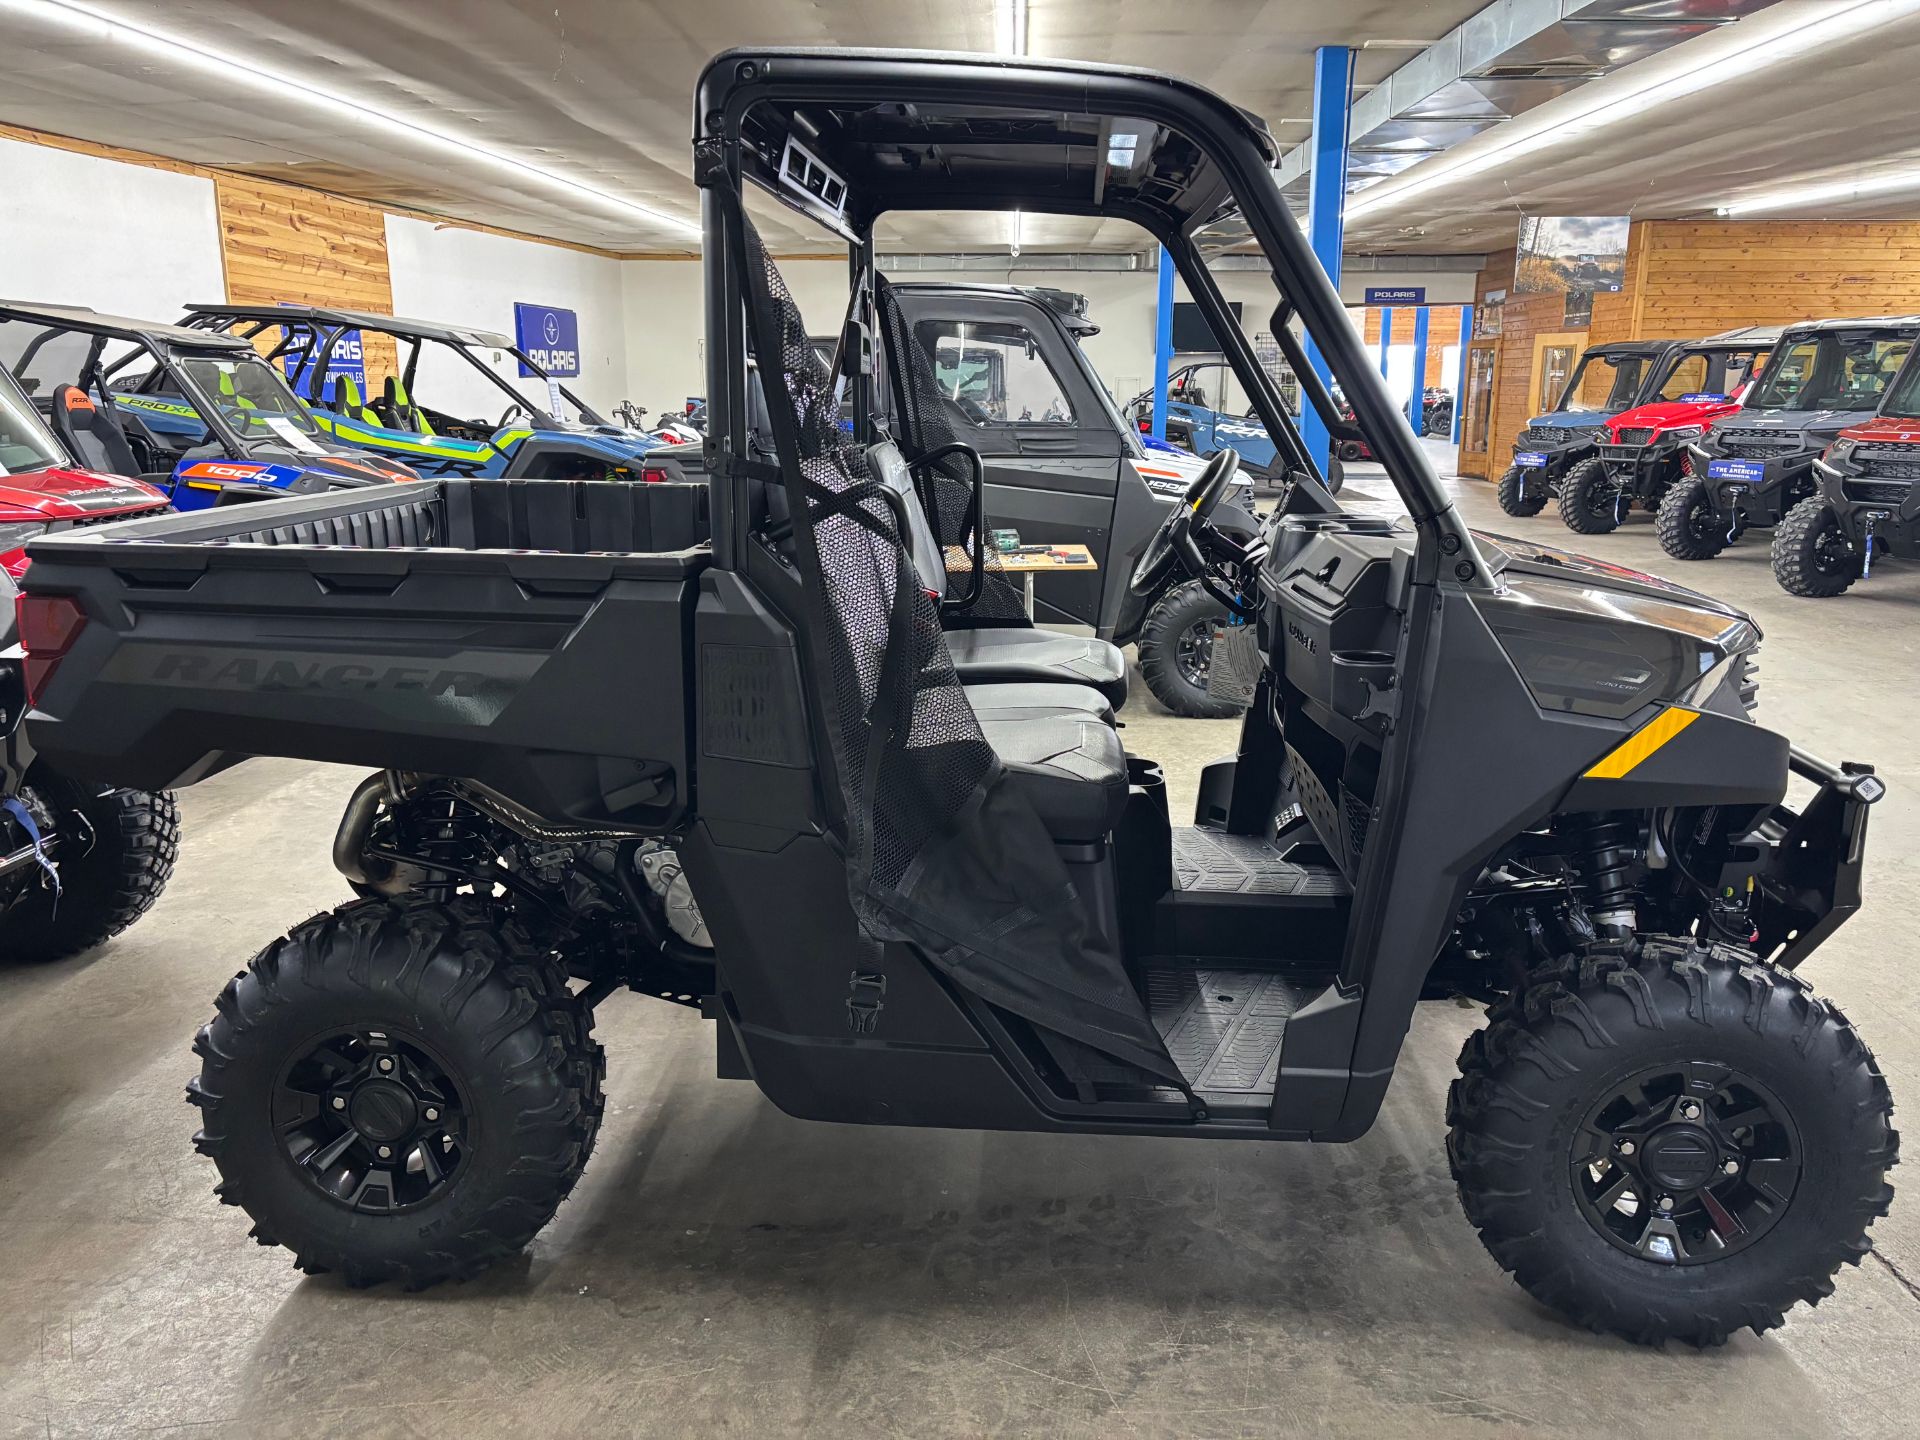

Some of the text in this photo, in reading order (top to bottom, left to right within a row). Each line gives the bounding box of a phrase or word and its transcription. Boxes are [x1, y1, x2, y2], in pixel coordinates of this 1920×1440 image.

[528, 349, 576, 371] POLARIS
[128, 399, 169, 411] PRO
[206, 465, 277, 482] 1000
[1728, 467, 1758, 475] AMERICAN
[152, 653, 488, 698] RANGER
